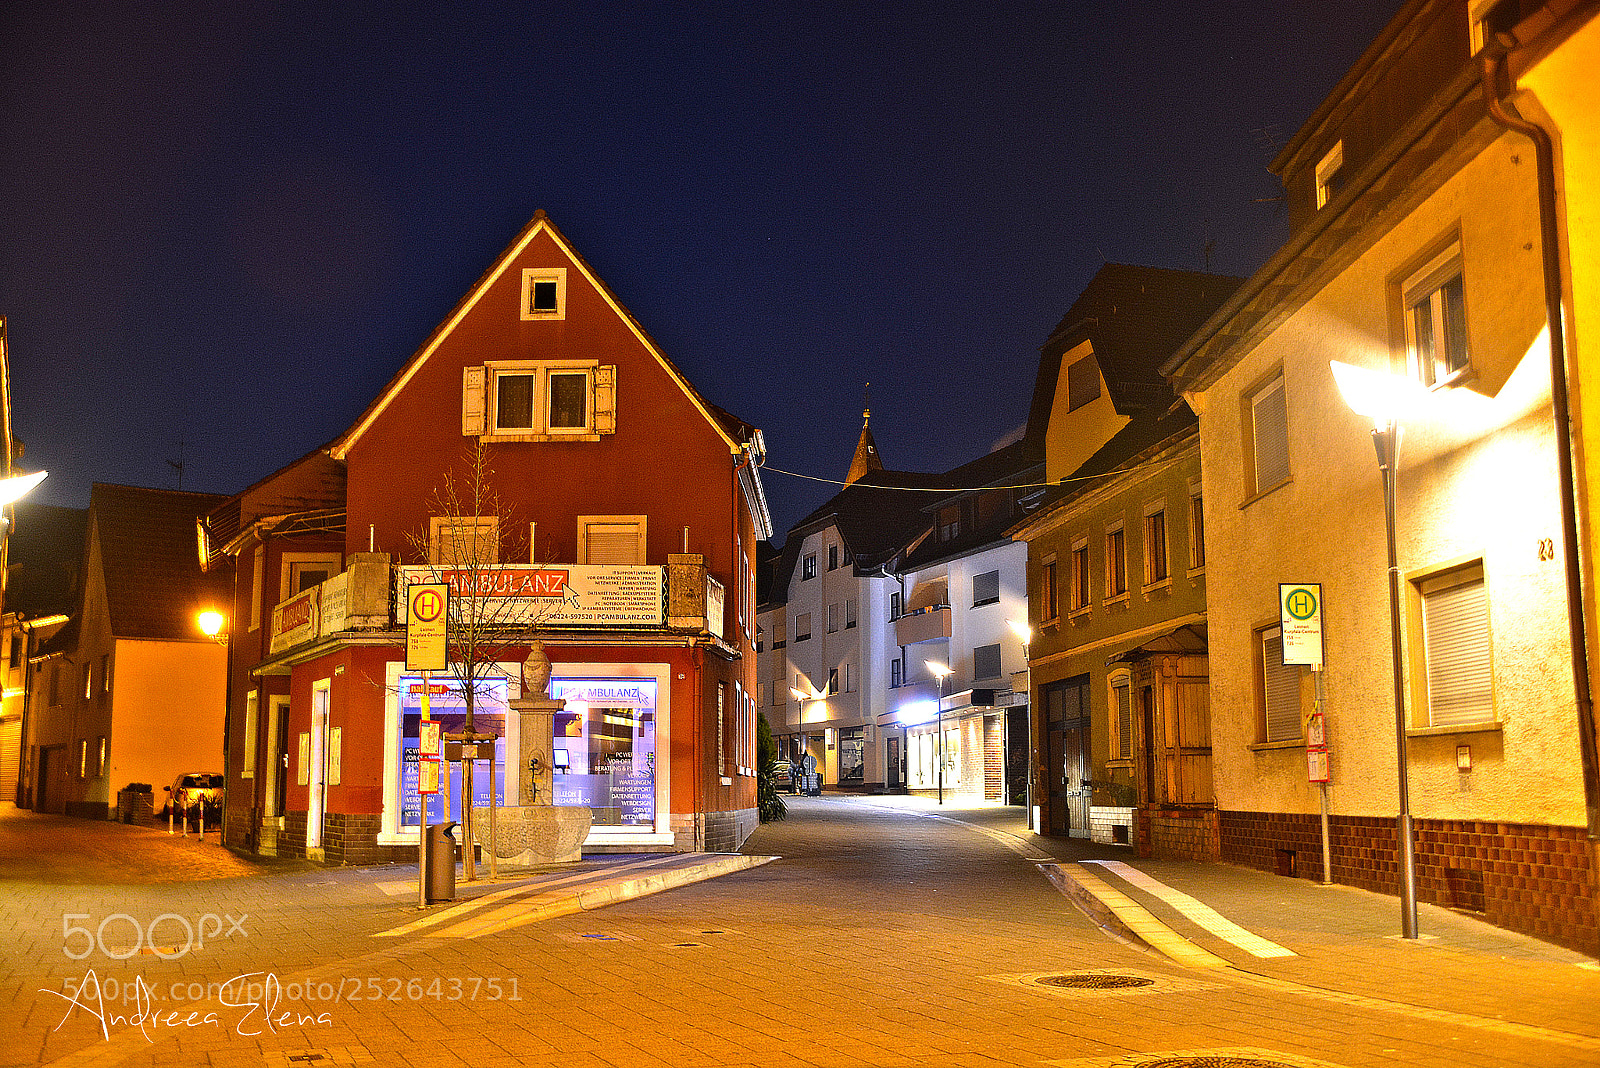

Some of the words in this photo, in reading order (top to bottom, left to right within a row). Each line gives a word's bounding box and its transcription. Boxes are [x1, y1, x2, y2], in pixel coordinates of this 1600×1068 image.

[449, 574, 564, 592] AMBULANZ
[422, 596, 434, 615] H
[1295, 596, 1307, 613] H
